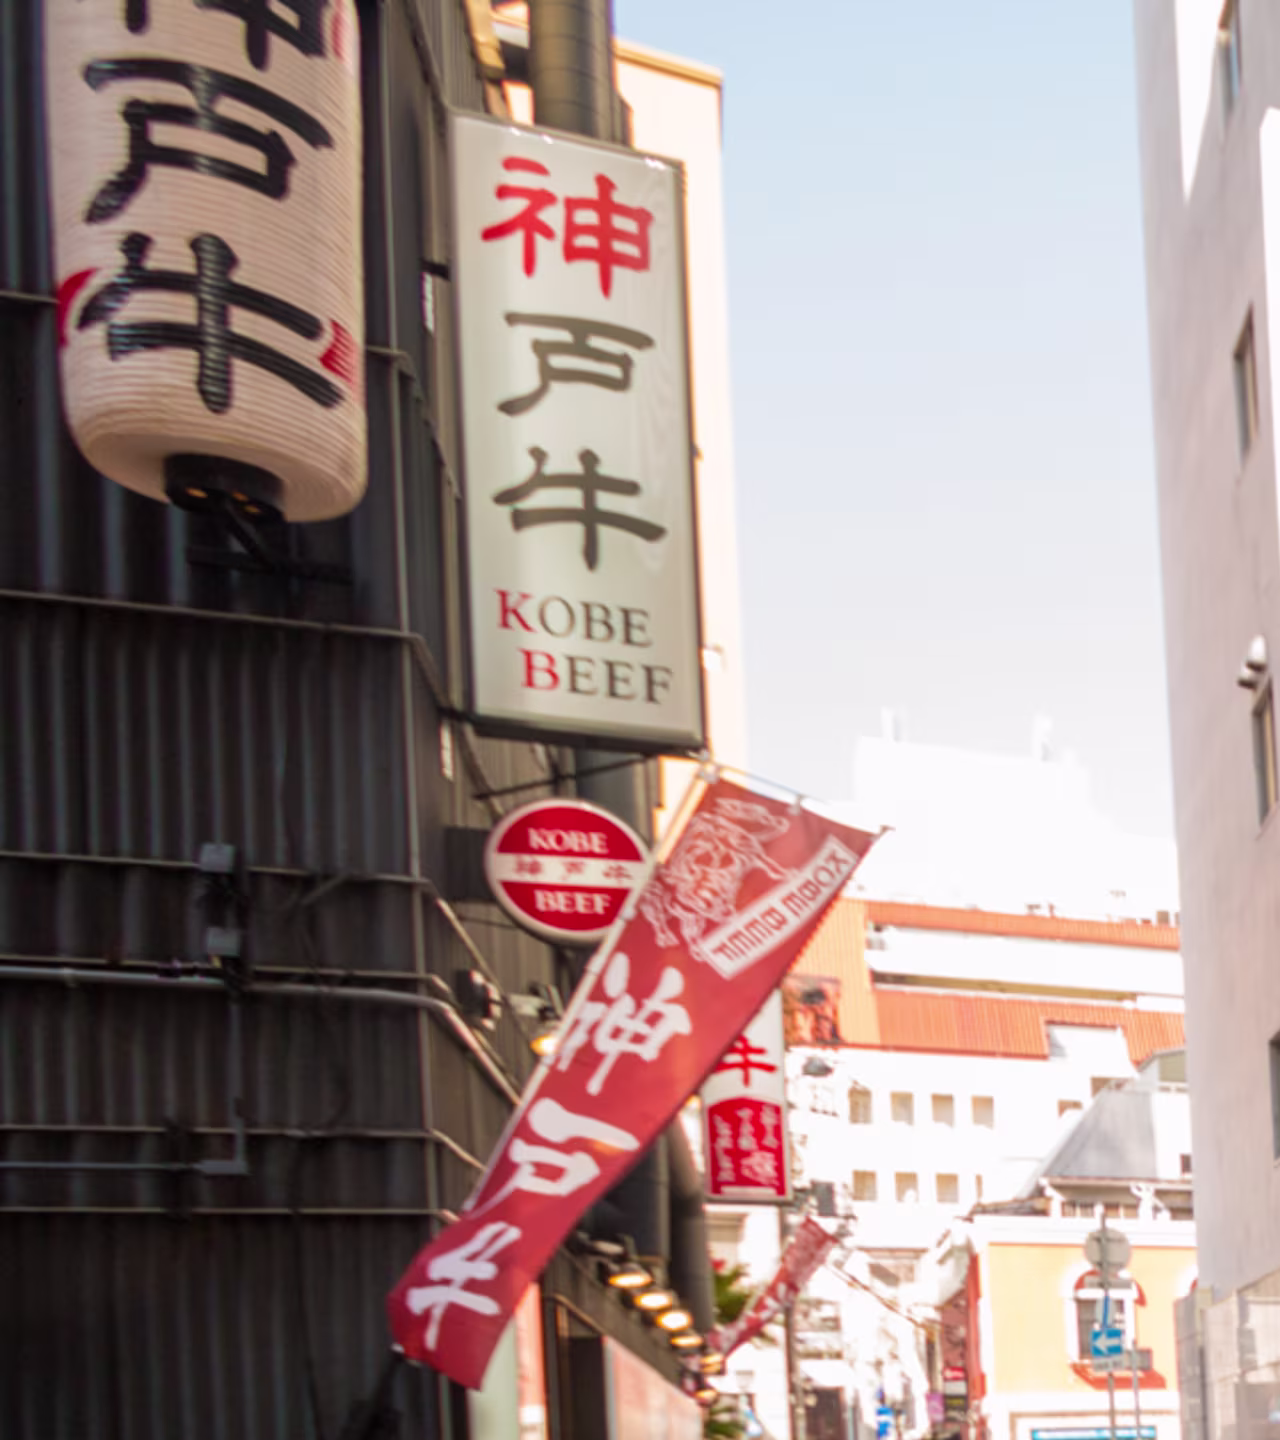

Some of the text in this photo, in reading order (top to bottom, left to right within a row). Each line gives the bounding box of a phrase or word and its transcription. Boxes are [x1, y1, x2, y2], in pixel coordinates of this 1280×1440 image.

[481, 156, 667, 572] 神戸牛
[493, 588, 653, 648] KOBE
[517, 647, 674, 705] BEEF
[527, 827, 609, 855] KOBE
[534, 889, 612, 915] BEEF
[406, 952, 693, 1351] 神戸牛
